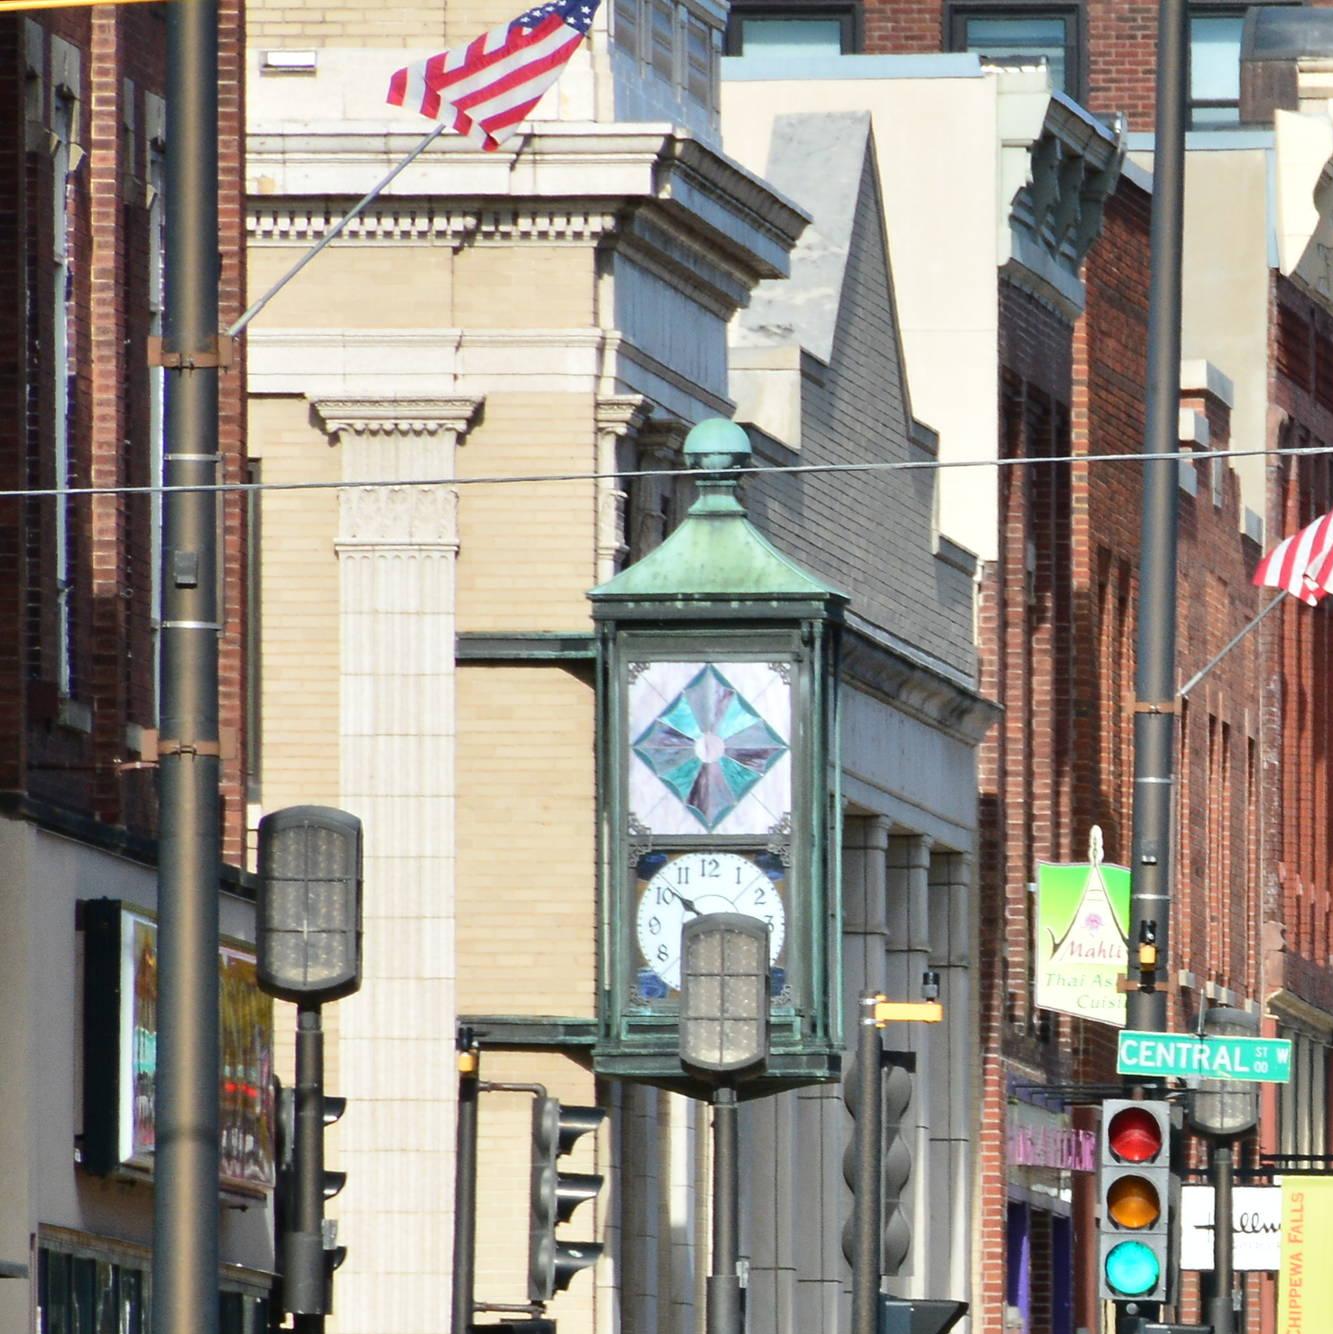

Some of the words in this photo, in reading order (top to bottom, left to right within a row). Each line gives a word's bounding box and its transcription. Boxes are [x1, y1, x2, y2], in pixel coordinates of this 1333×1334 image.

[701, 859, 721, 878] 12
[754, 888, 767, 905] 2
[648, 916, 662, 935] 9
[656, 944, 670, 961] 8
[1120, 1039, 1249, 1073] CENTRAL
[1255, 1046, 1268, 1057] ST
[1276, 1047, 1289, 1064] W
[1288, 1192, 1305, 1244] FALLS
